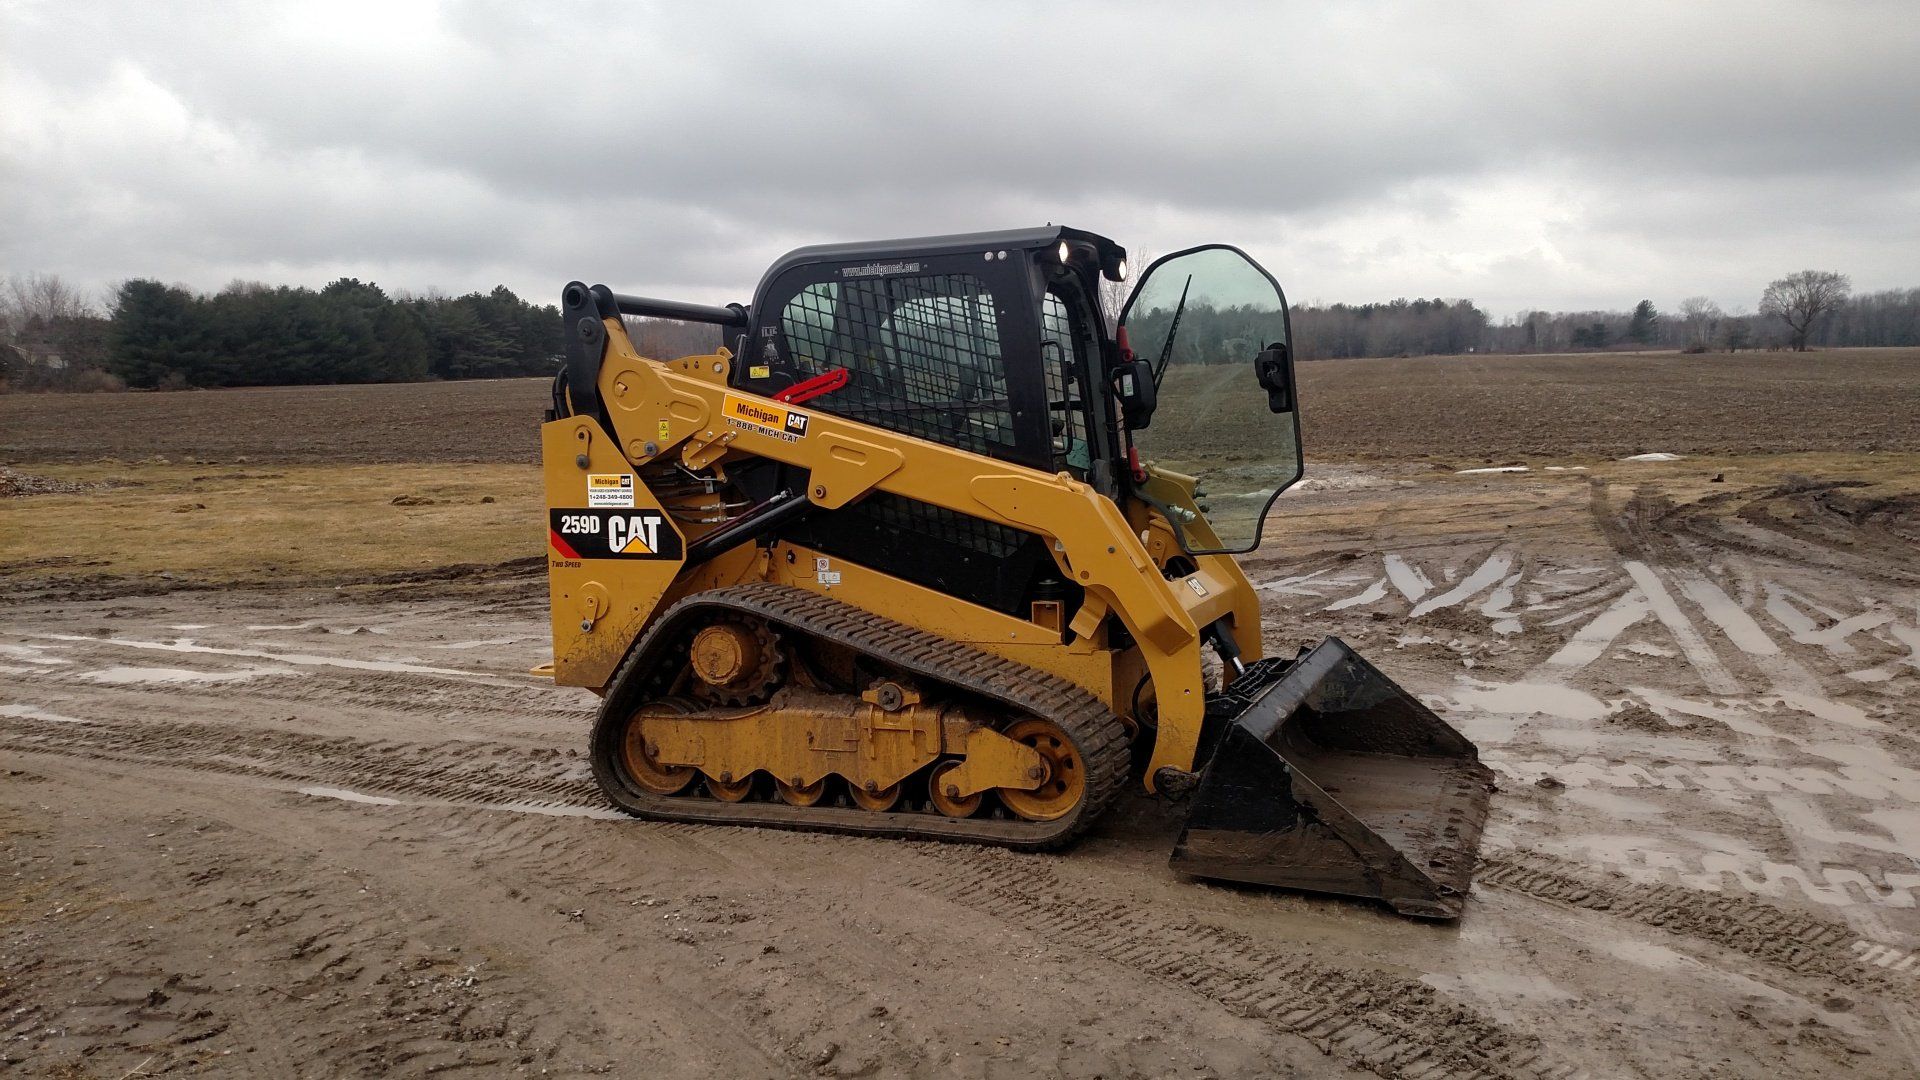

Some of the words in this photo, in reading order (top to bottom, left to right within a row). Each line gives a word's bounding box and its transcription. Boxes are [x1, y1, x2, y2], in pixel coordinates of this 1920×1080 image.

[842, 262, 920, 277] www.michigancat.com
[737, 403, 779, 422] Michigan
[787, 414, 807, 430] CAT
[782, 434, 798, 442] CAT
[594, 478, 619, 486] Michigan
[561, 515, 600, 534] 259D
[608, 515, 661, 553] CAT
